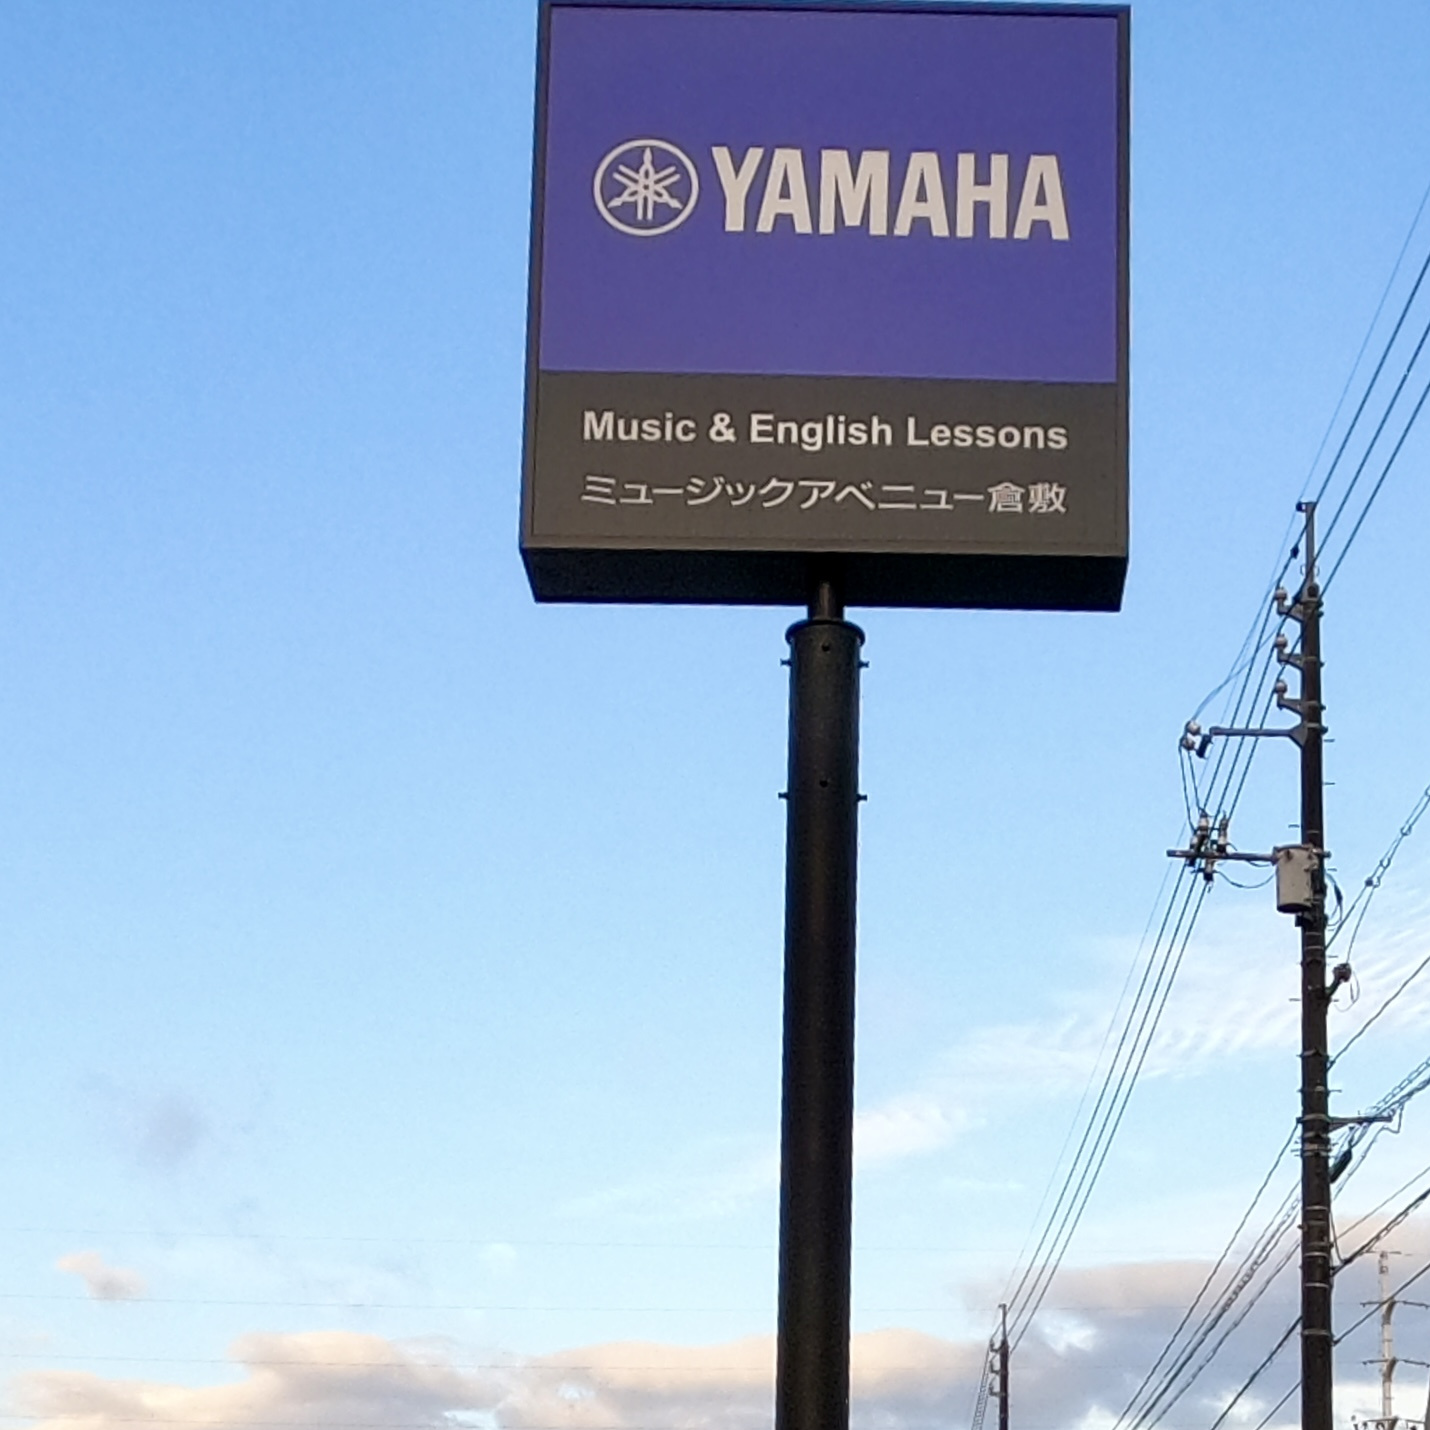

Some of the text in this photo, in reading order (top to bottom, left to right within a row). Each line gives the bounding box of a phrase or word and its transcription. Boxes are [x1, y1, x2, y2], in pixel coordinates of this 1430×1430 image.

[712, 146, 1069, 241] YAMAHA
[583, 410, 1068, 451] Music & English Lessons
[581, 475, 1067, 514] ミュージックアベニュー倉敷
